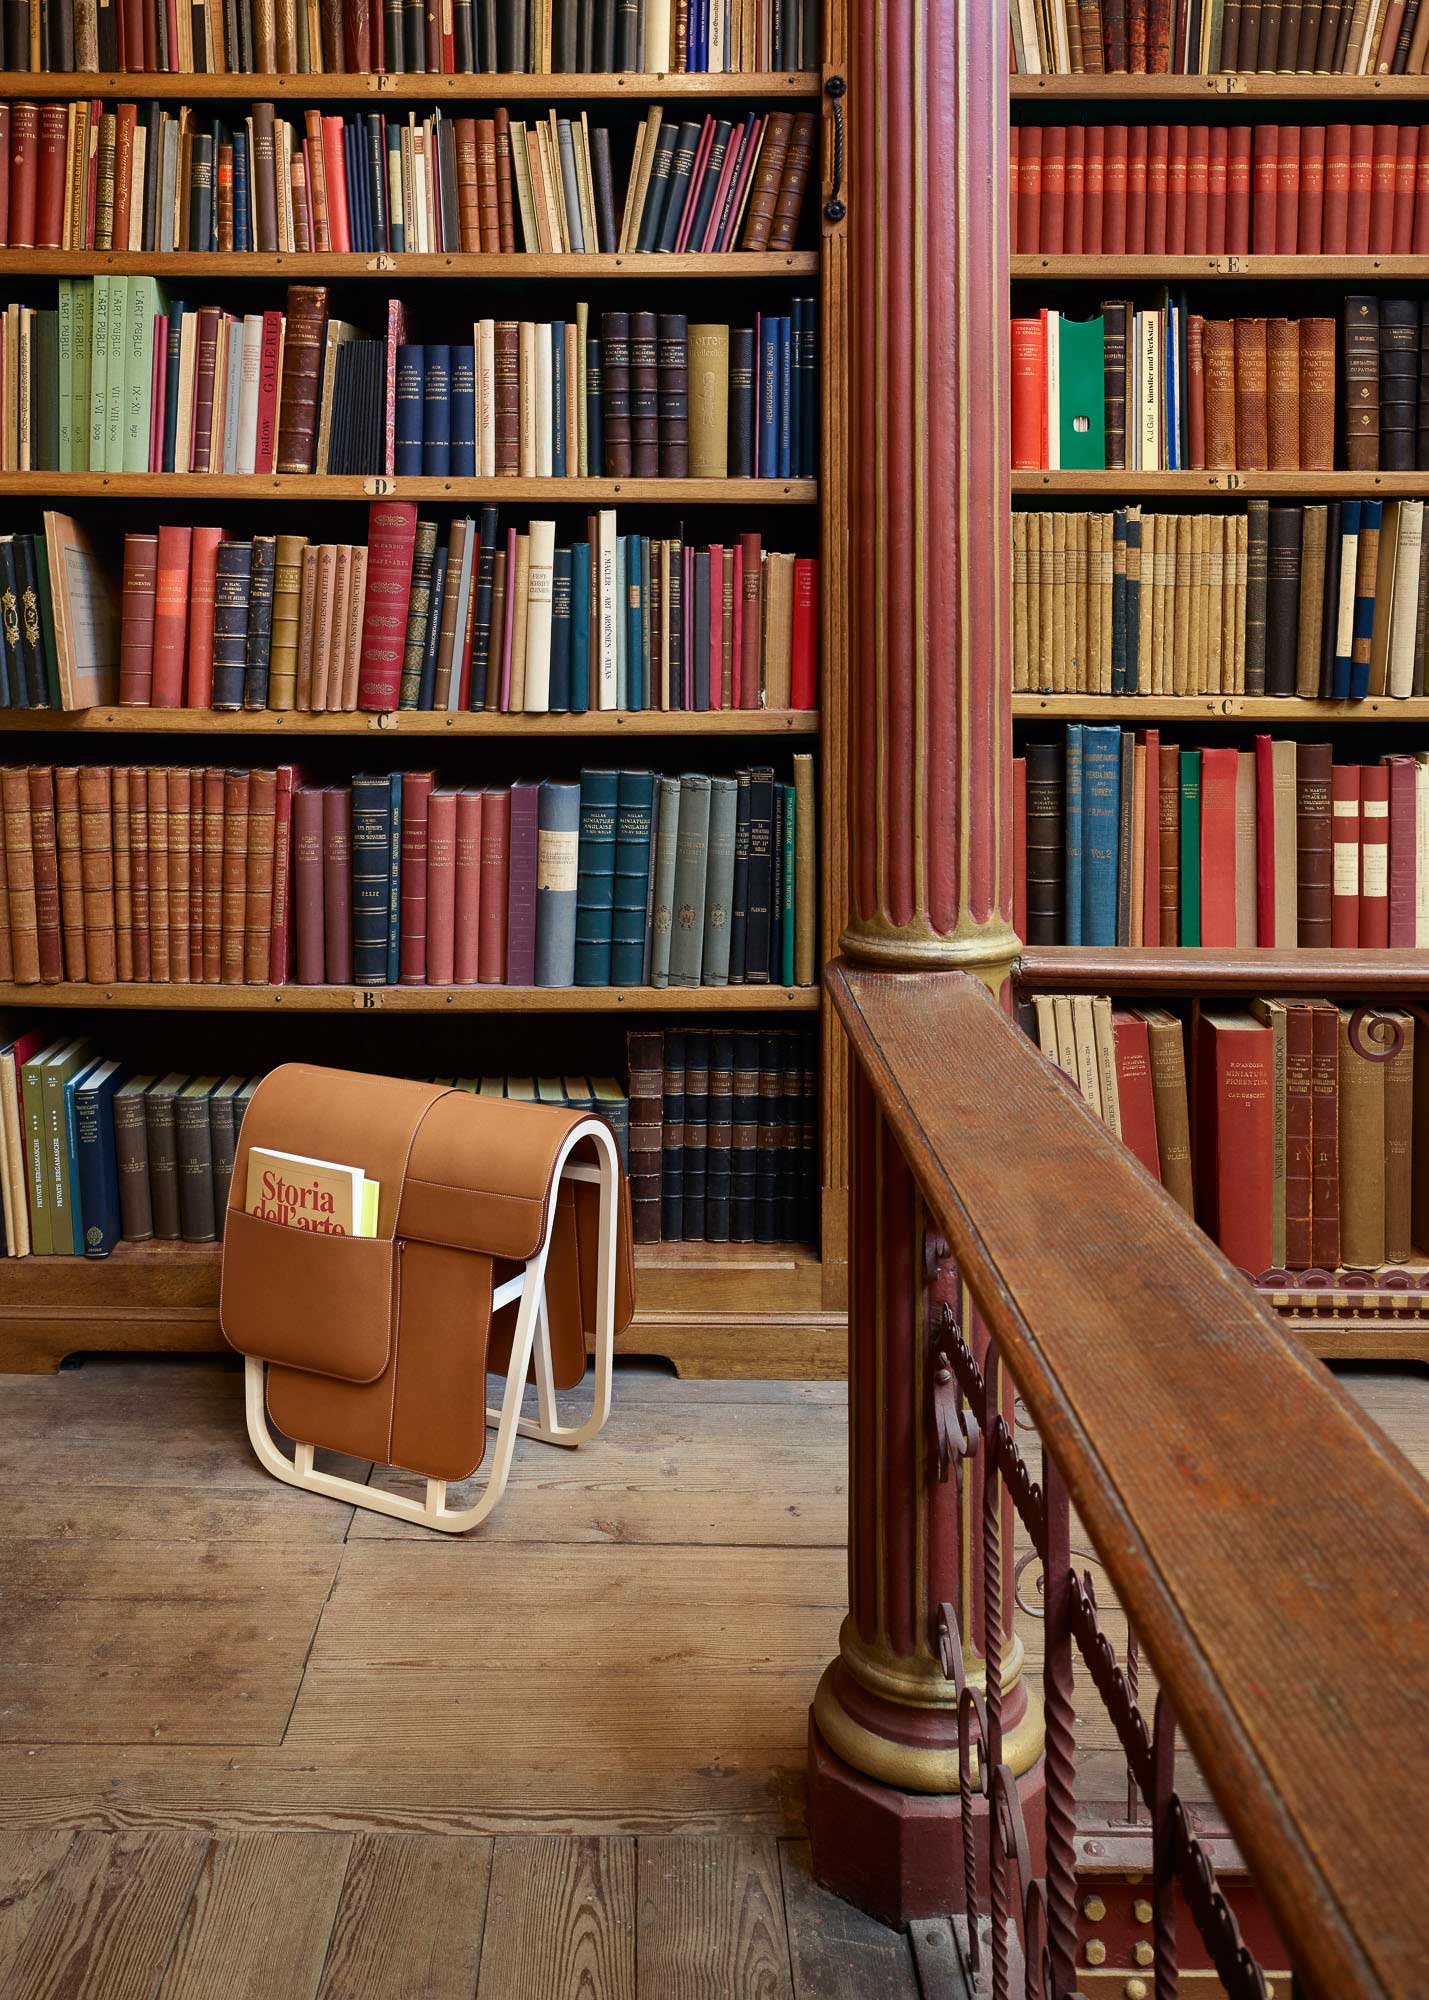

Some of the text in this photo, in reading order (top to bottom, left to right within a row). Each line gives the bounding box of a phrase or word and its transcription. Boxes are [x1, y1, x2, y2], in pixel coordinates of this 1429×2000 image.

[377, 76, 390, 92] F
[1226, 78, 1238, 94] F
[376, 255, 388, 270] E
[1227, 256, 1240, 272] E
[61, 293, 70, 320] L'ART
[75, 293, 84, 321] L'ART
[97, 289, 107, 317] L'ART
[112, 289, 122, 318] L'ART
[134, 290, 145, 318] L'ART
[60, 325, 70, 359] PUBLIC
[74, 325, 84, 360] PUBLIC
[96, 320, 106, 356] PUBLIC
[111, 322, 121, 357] PUBLIC
[132, 322, 143, 357] PUBLIC
[1146, 320, 1154, 356] Werkstatt
[263, 316, 278, 393] GALERIE
[1146, 356, 1154, 371] und
[766, 342, 774, 424] NEURUSSISCHE KUNST
[1146, 372, 1154, 404] Künstler
[374, 479, 387, 494] D
[1228, 474, 1240, 488] D
[435, 568, 443, 592] BEITRÄGE
[604, 558, 612, 586] MACLER
[604, 596, 612, 609] ART
[430, 609, 439, 657] KUNSTGESCHICHTE
[604, 614, 612, 648] ARMÉNIEN
[604, 657, 612, 680] ATLAS
[377, 713, 390, 729] C
[1221, 700, 1233, 715] C
[363, 992, 375, 1008] B
[1086, 1067, 1094, 1089] TAFEL
[1105, 1070, 1113, 1091] TAFEL
[1225, 1078, 1268, 1086] FIORENTINA
[1106, 1094, 1113, 1102] IV
[1273, 1037, 1284, 1179] NOORD-NEDERLANDSCHE MINIA
[33, 1138, 42, 1183] BERGAMASCHE
[1320, 1153, 1328, 1161] II
[53, 1138, 63, 1207] PRIVATE BERGAMASCHE
[260, 1170, 335, 1214] Storia
